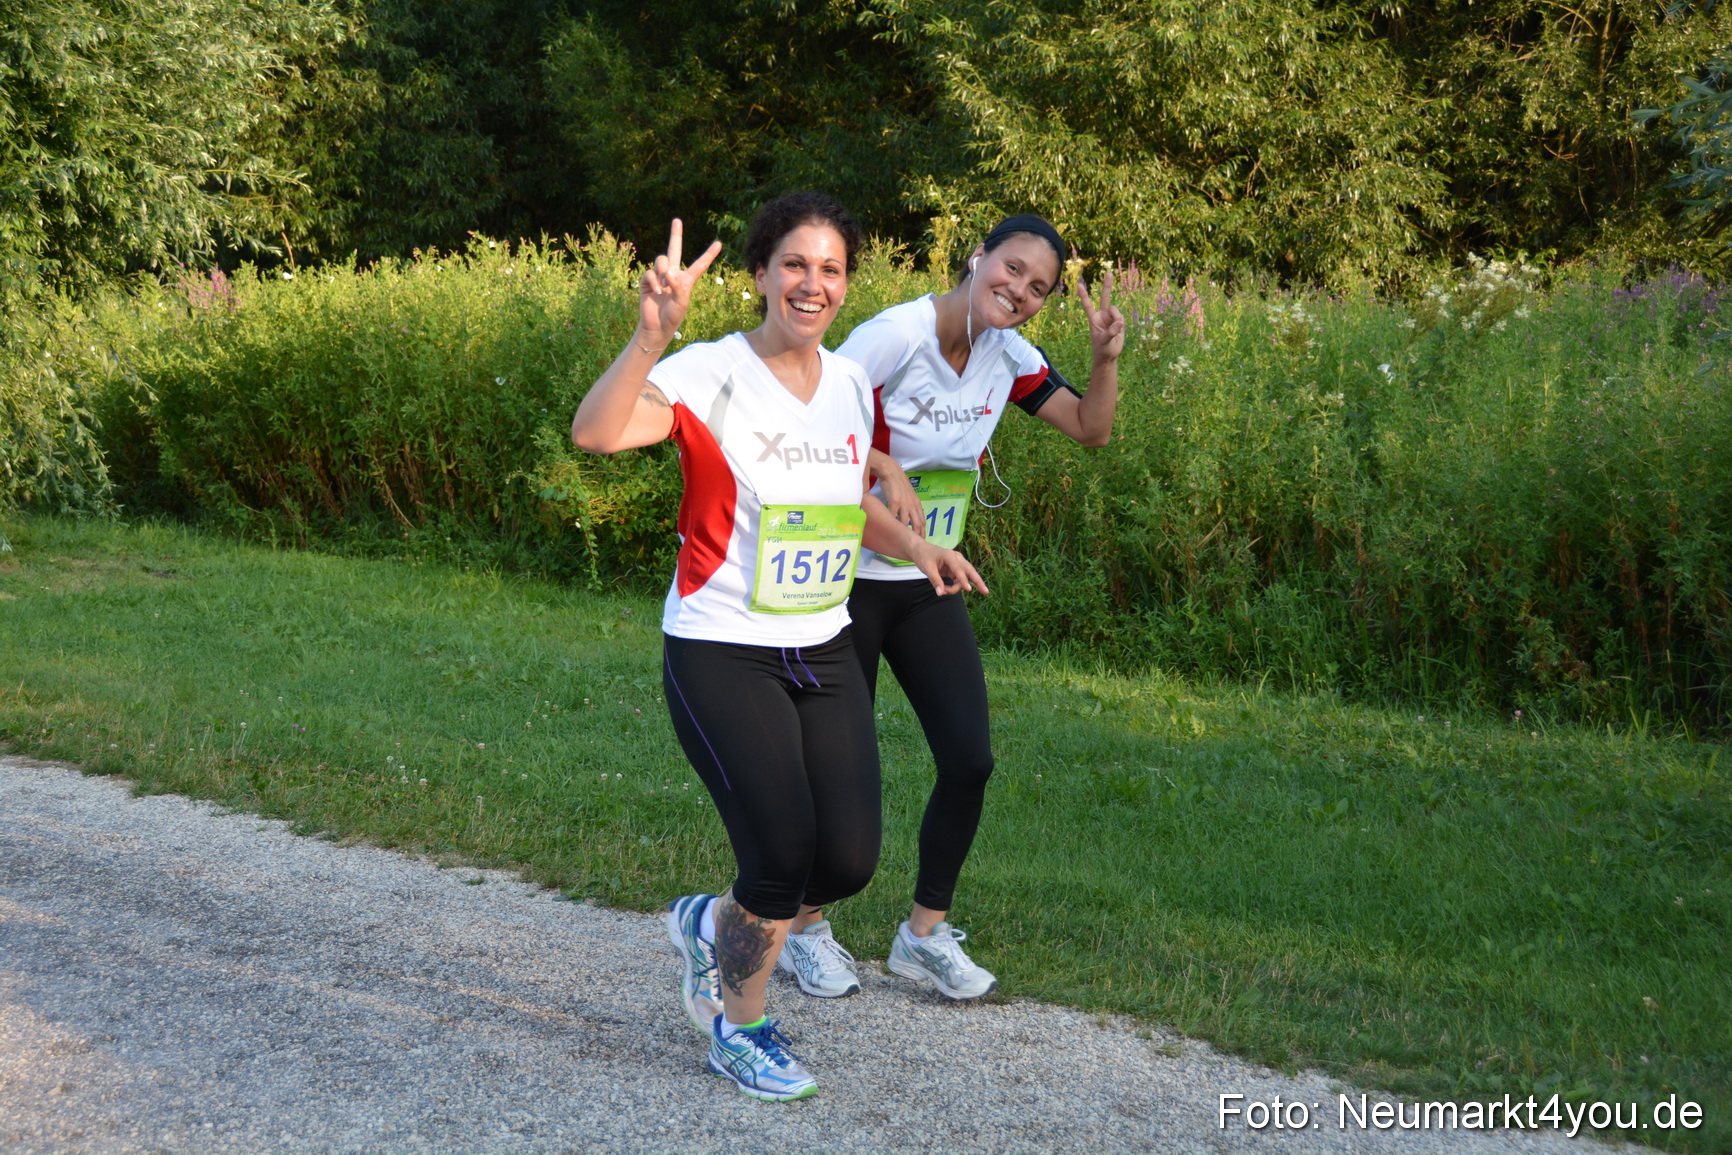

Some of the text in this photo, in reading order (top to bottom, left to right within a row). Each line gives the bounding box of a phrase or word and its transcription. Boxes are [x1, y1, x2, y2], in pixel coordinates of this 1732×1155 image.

[752, 431, 860, 470] Xplus1
[908, 506, 955, 537] 11
[770, 548, 851, 584] 1512
[806, 591, 832, 599] Vanselow
